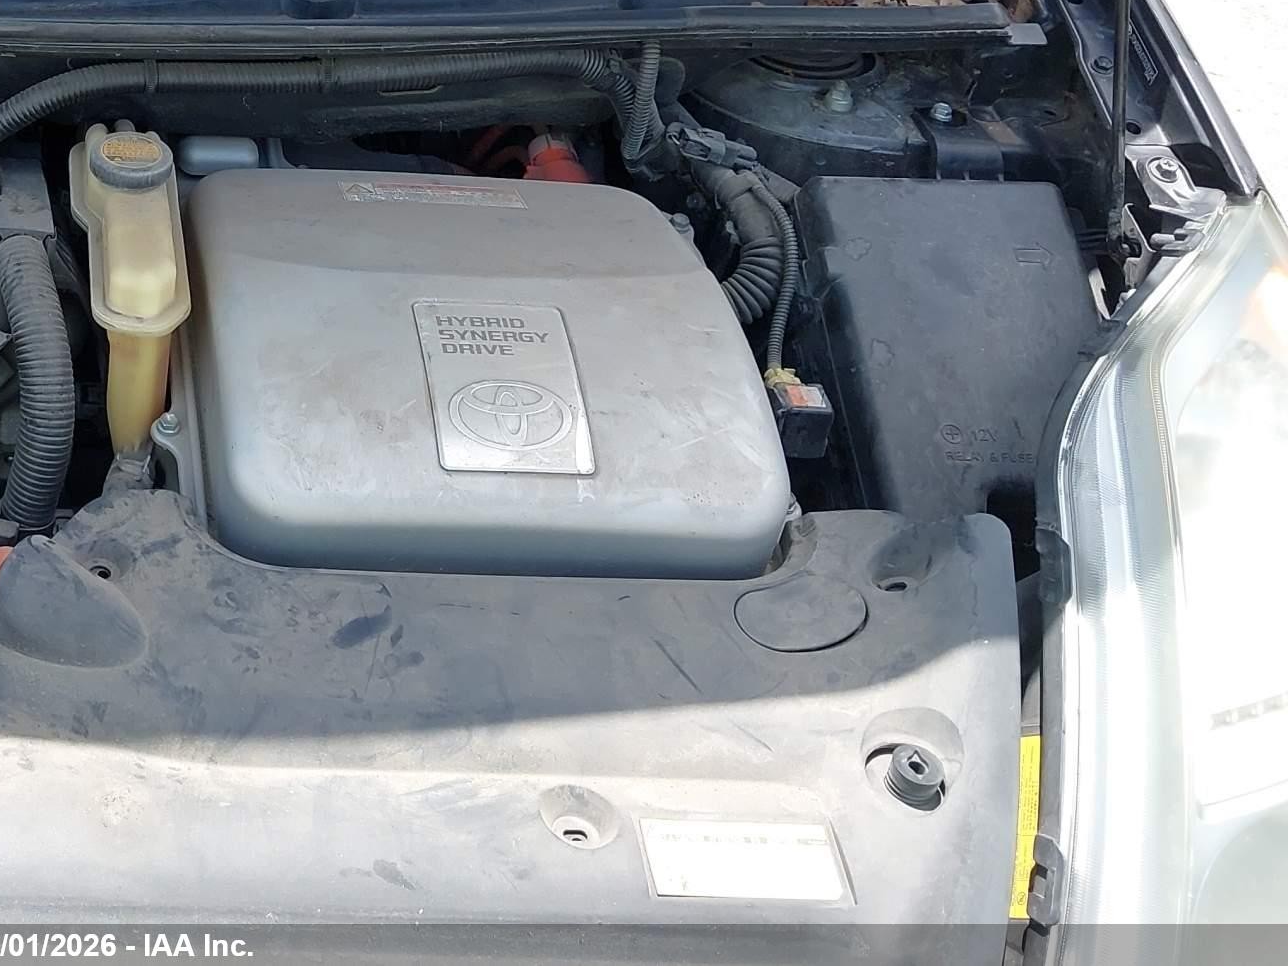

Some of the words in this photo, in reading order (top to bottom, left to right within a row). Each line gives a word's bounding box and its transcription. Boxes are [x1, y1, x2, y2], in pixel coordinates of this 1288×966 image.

[434, 315, 525, 329] HYBRID
[438, 328, 549, 343] SYNERGY
[441, 343, 515, 356] DRIVE
[1001, 452, 1033, 464] FUSE
